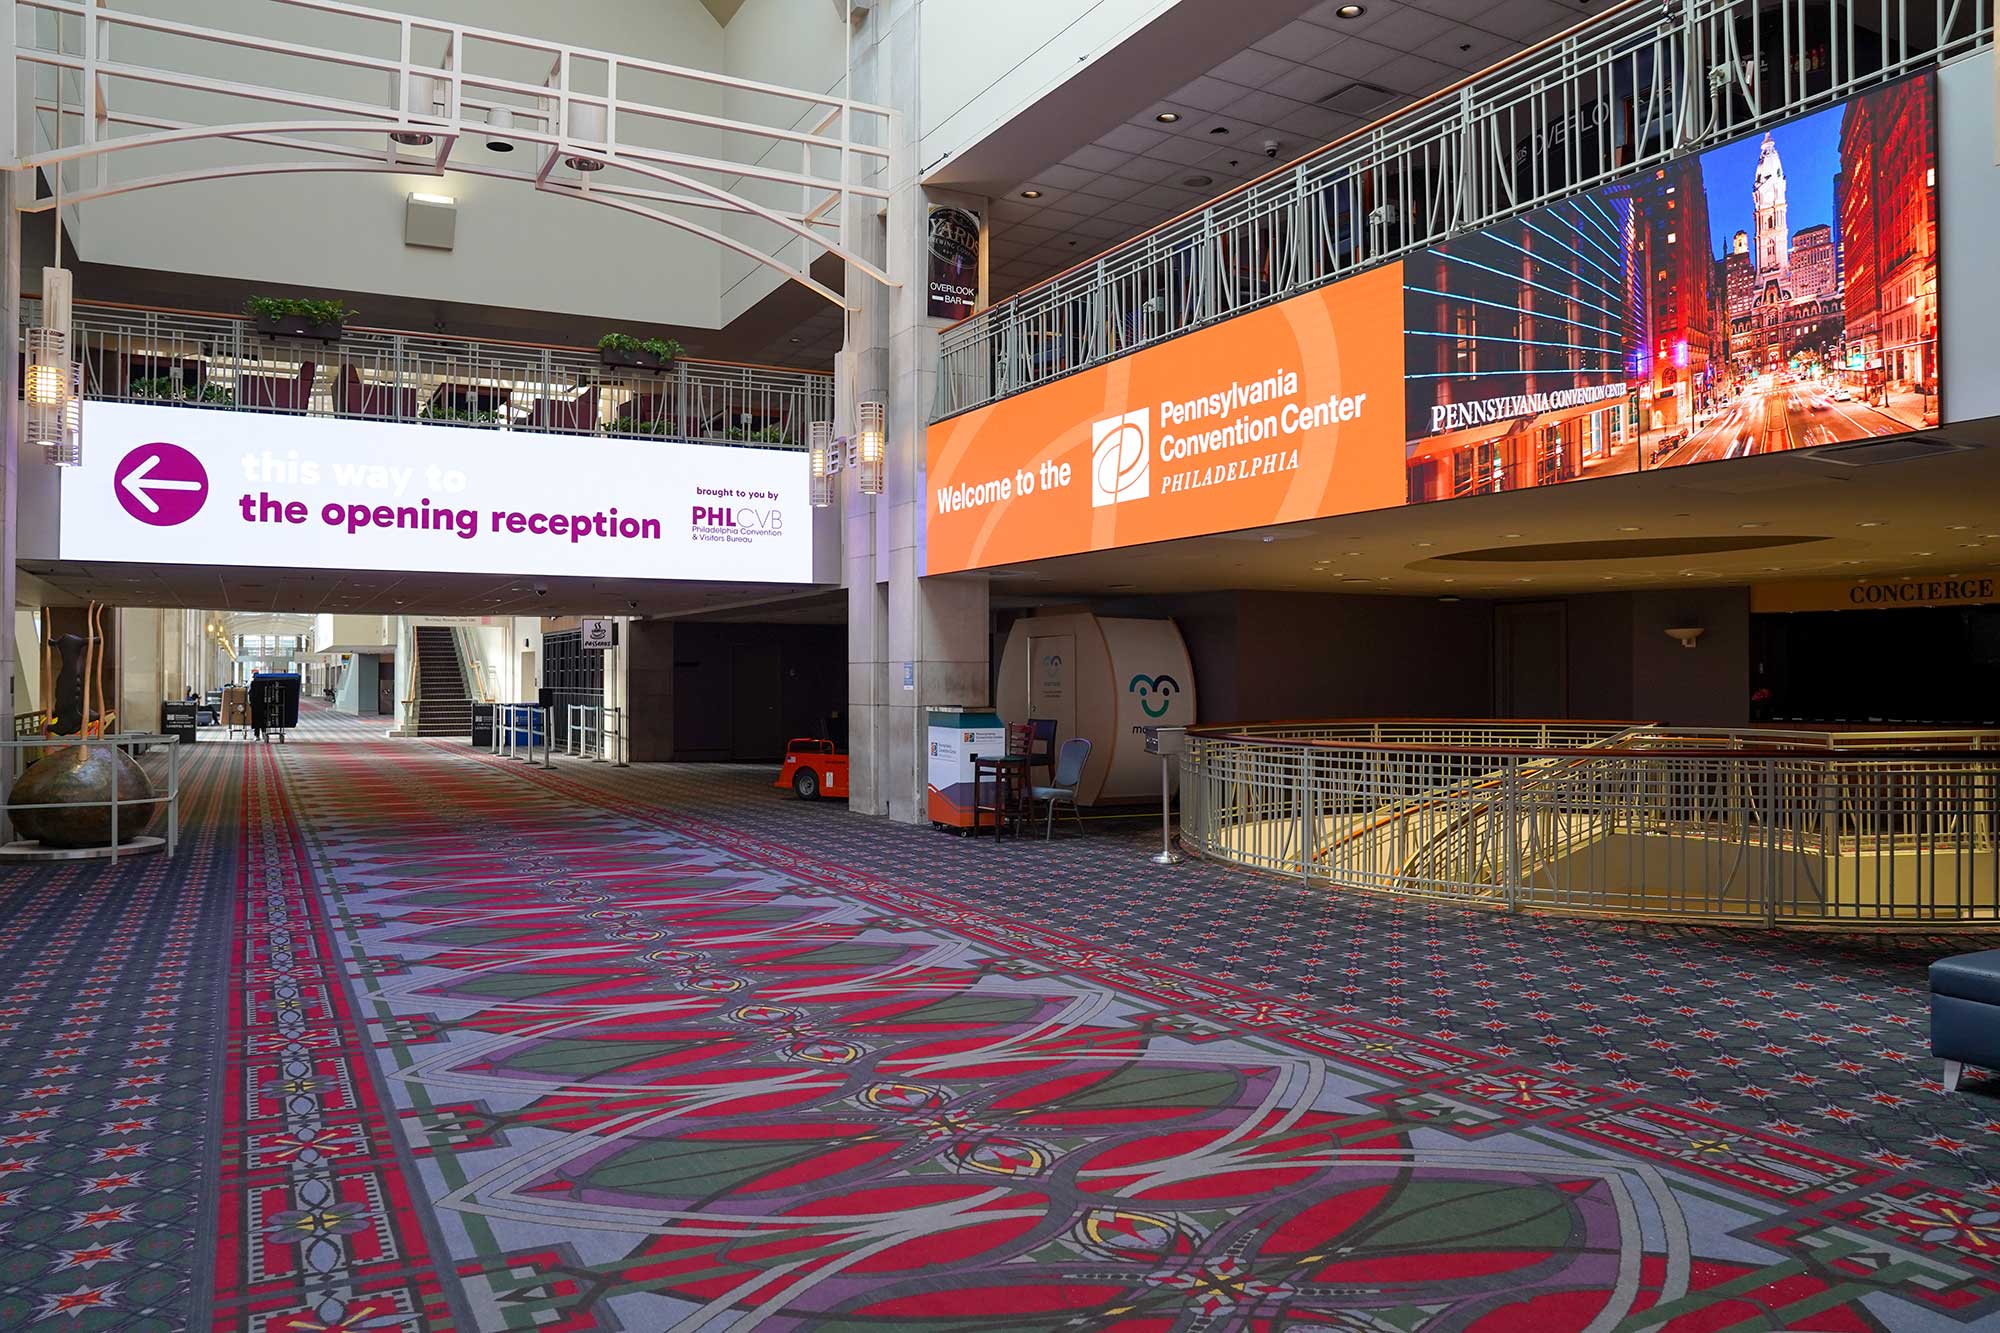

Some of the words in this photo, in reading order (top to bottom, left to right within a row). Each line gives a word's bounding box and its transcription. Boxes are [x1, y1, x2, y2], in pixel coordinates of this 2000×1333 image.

[929, 218, 979, 257] YARDS
[930, 282, 974, 296] OVERLOOK
[944, 295, 962, 304] BAR
[1160, 368, 1298, 428] Pennsylvania
[1431, 393, 1549, 432] PENNSYLVANIA
[1552, 384, 1605, 409] CONVENTION
[1604, 382, 1627, 399] CENTER
[1160, 415, 1278, 462] Convention
[1281, 393, 1366, 434] Center
[241, 450, 321, 486] this
[332, 461, 414, 497] way
[425, 464, 468, 493] to
[937, 477, 1011, 514] Welcome
[1016, 468, 1035, 496] to
[1040, 459, 1072, 491] the
[1160, 448, 1300, 495] PHILADELPHIA
[696, 486, 733, 498] brought
[736, 490, 746, 498] to
[748, 492, 764, 500] you
[768, 491, 778, 501] by
[239, 492, 308, 523] the
[321, 498, 478, 540] opening
[491, 508, 661, 544] reception
[692, 506, 783, 530] PHLCVB
[692, 526, 738, 535] Philadelphia
[740, 528, 782, 536] Convention
[699, 534, 725, 542] Visitors
[726, 534, 753, 543] Bureau
[1850, 579, 1993, 604] CONCIERGE
